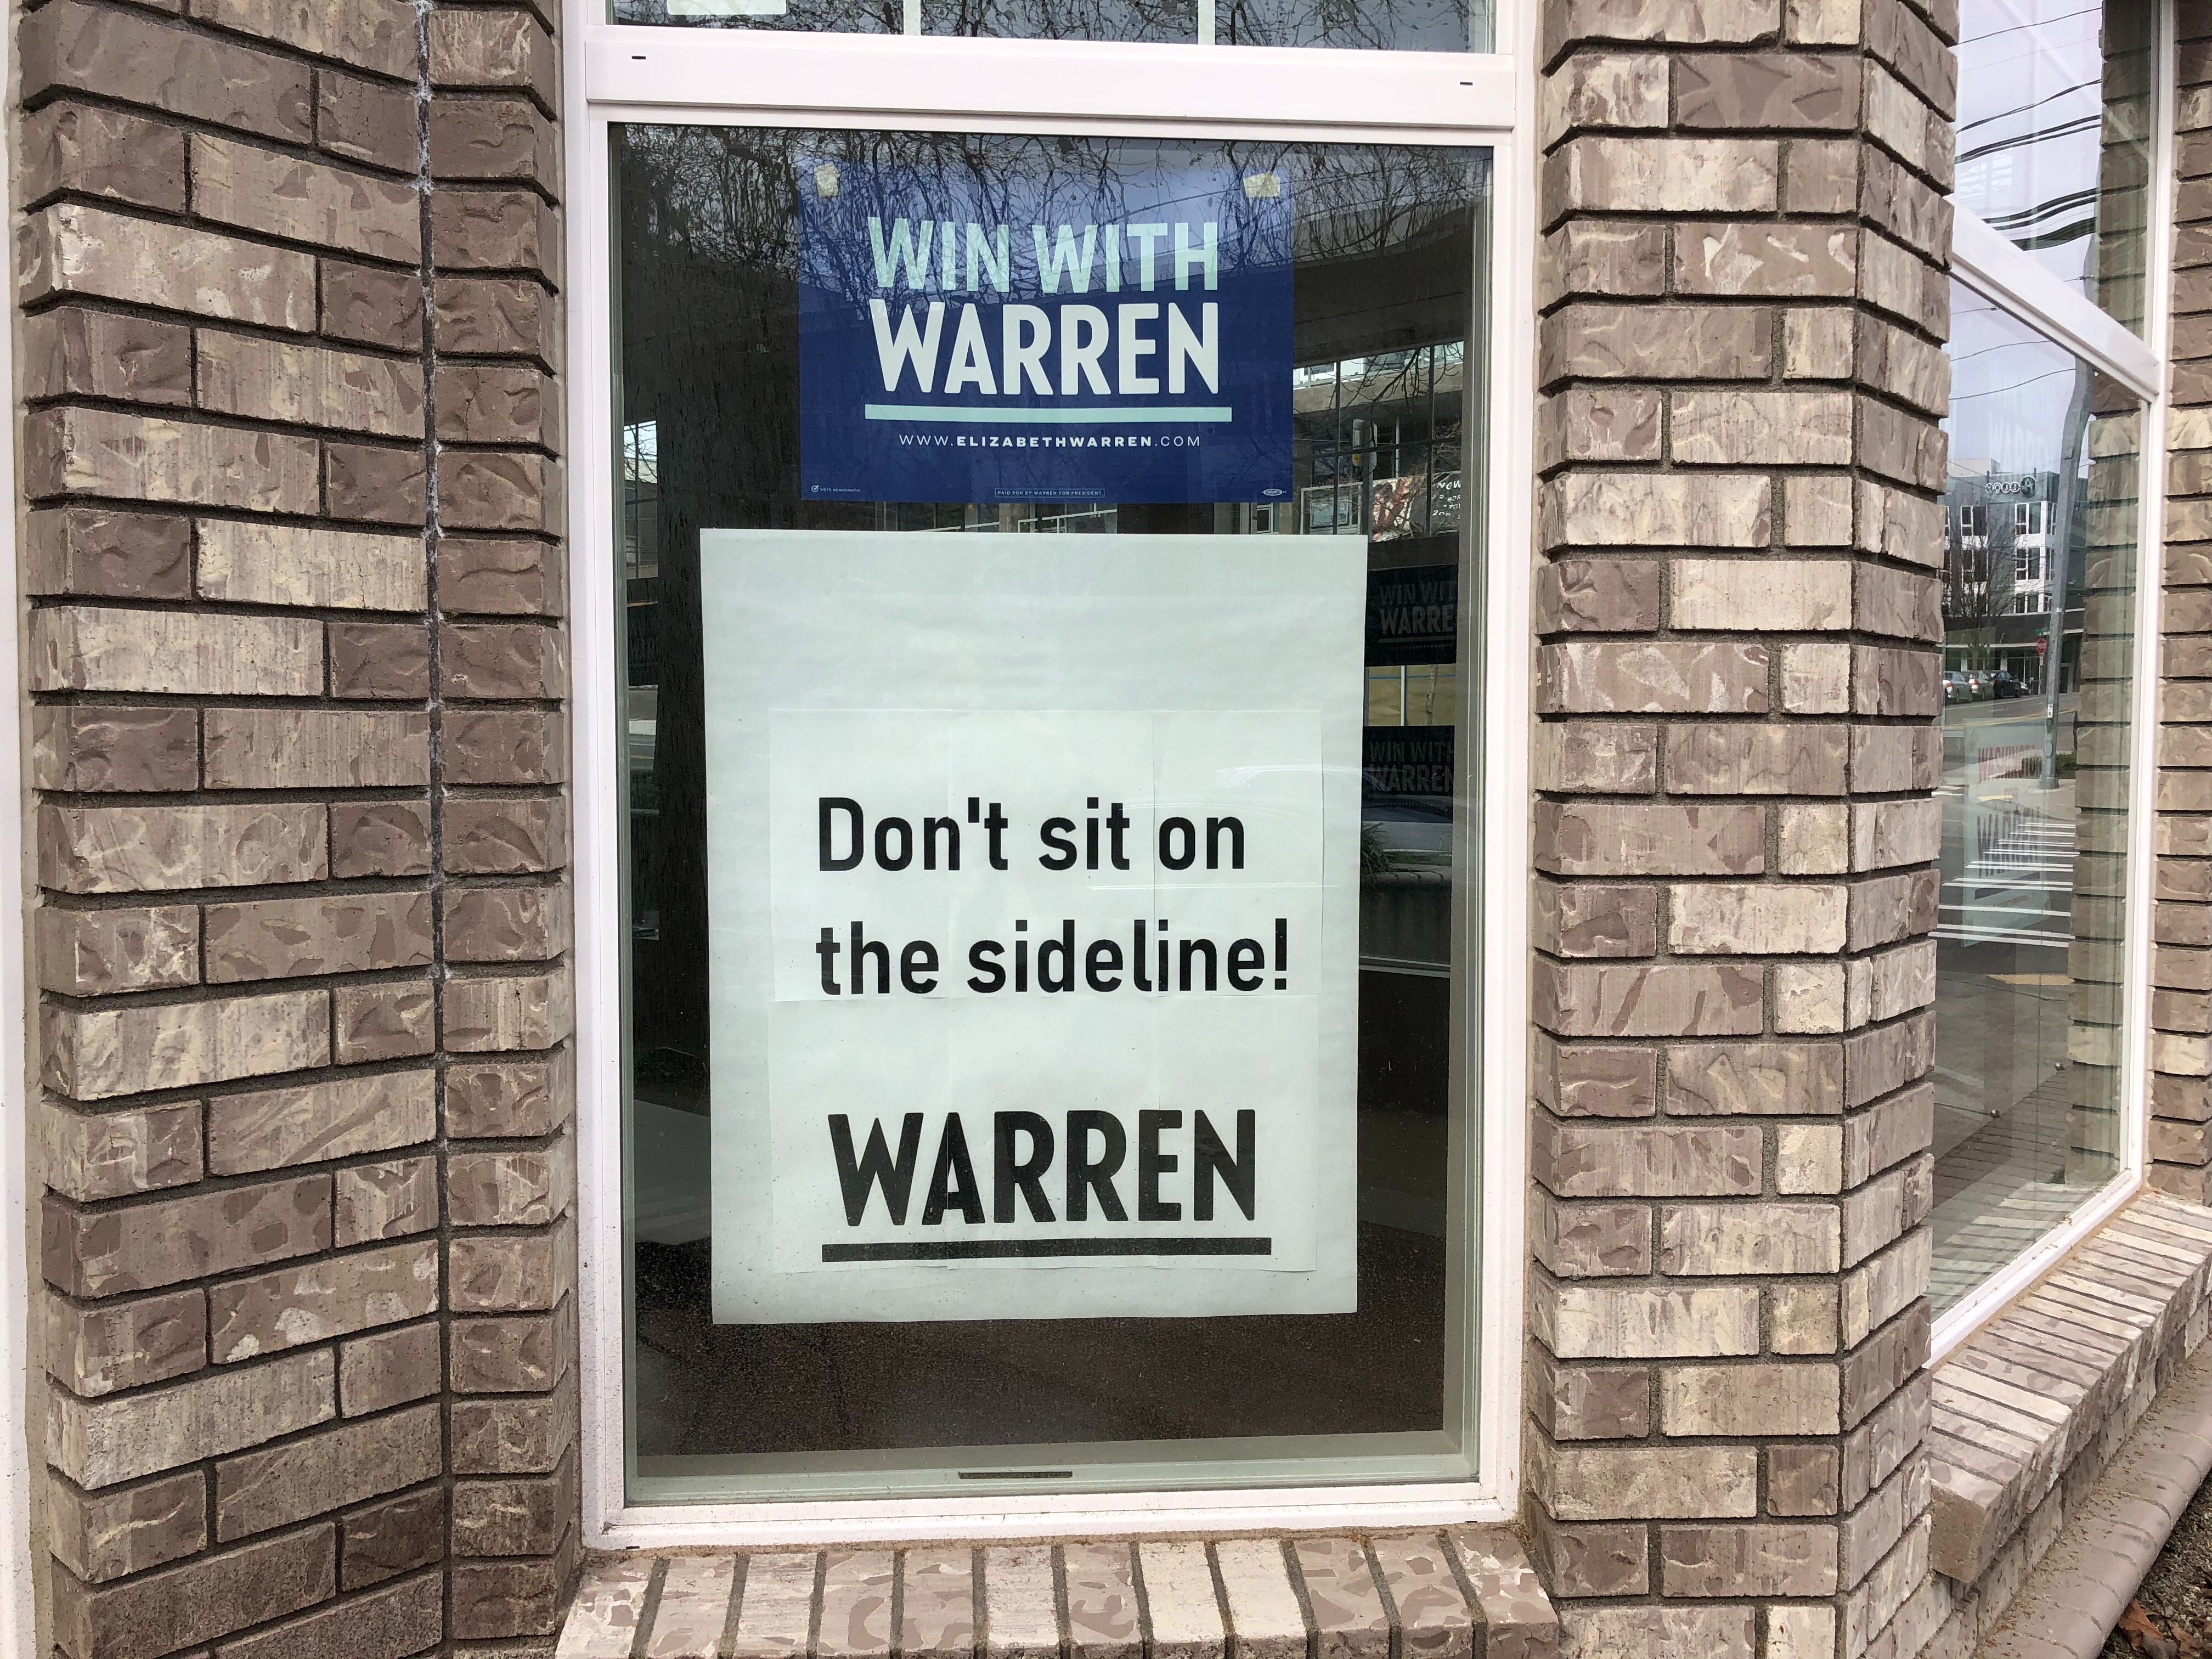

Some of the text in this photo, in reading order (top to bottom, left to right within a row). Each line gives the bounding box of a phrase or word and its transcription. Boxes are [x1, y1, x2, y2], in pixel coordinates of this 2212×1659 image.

[867, 217, 1218, 293] WIN WITH
[868, 298, 1218, 395] WARREN
[899, 434, 1200, 448] WWW.ELIZABETHWARREN.COM
[1379, 605, 1455, 635] WARRE
[1420, 580, 1457, 603] WIT
[818, 797, 1245, 871] Don't sit on
[816, 918, 1288, 995] the sideline!
[828, 1109, 1256, 1227] WARREN
